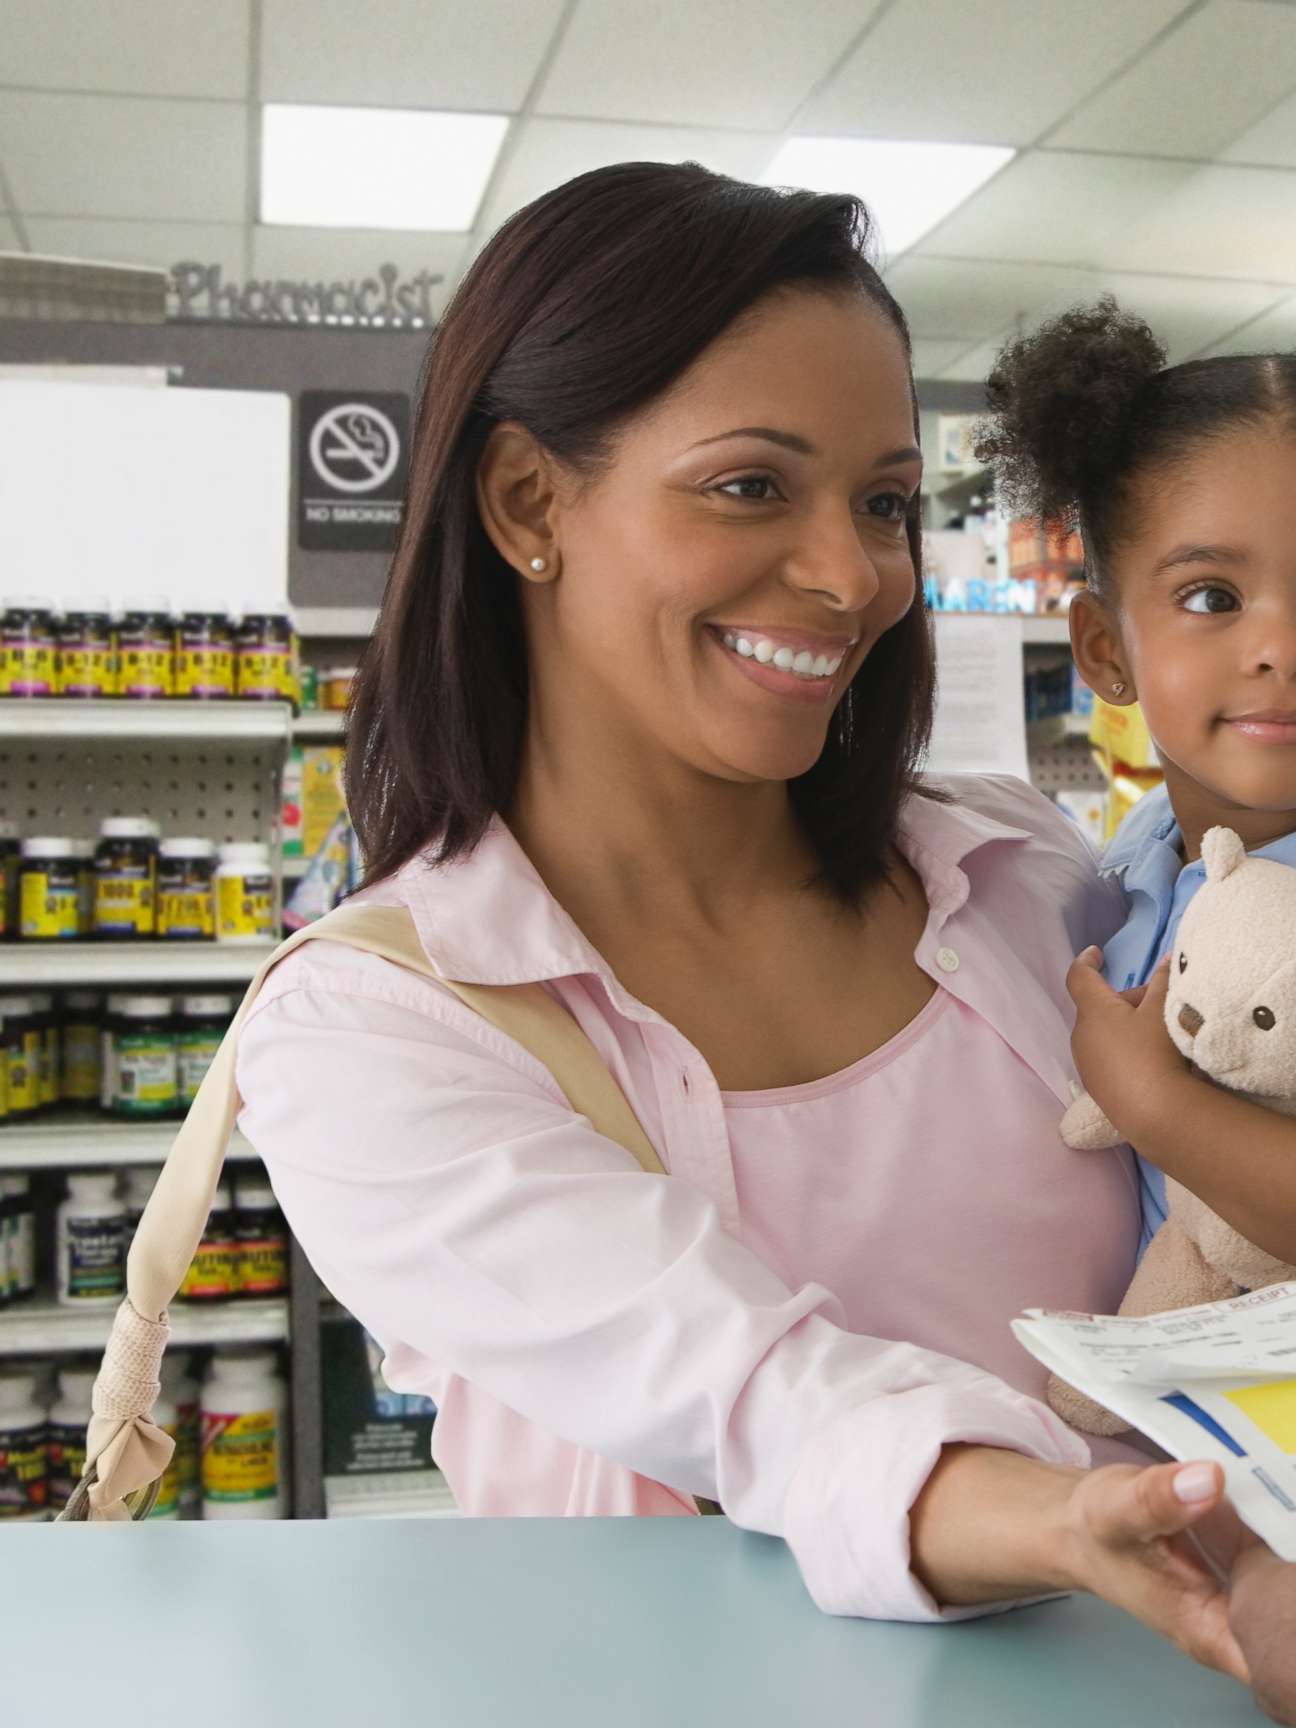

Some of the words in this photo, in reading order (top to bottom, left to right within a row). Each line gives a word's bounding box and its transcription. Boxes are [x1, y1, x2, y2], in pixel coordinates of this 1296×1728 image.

[169, 261, 444, 324] Pharmacist
[306, 508, 329, 523] NO
[333, 508, 401, 524] SMOKING
